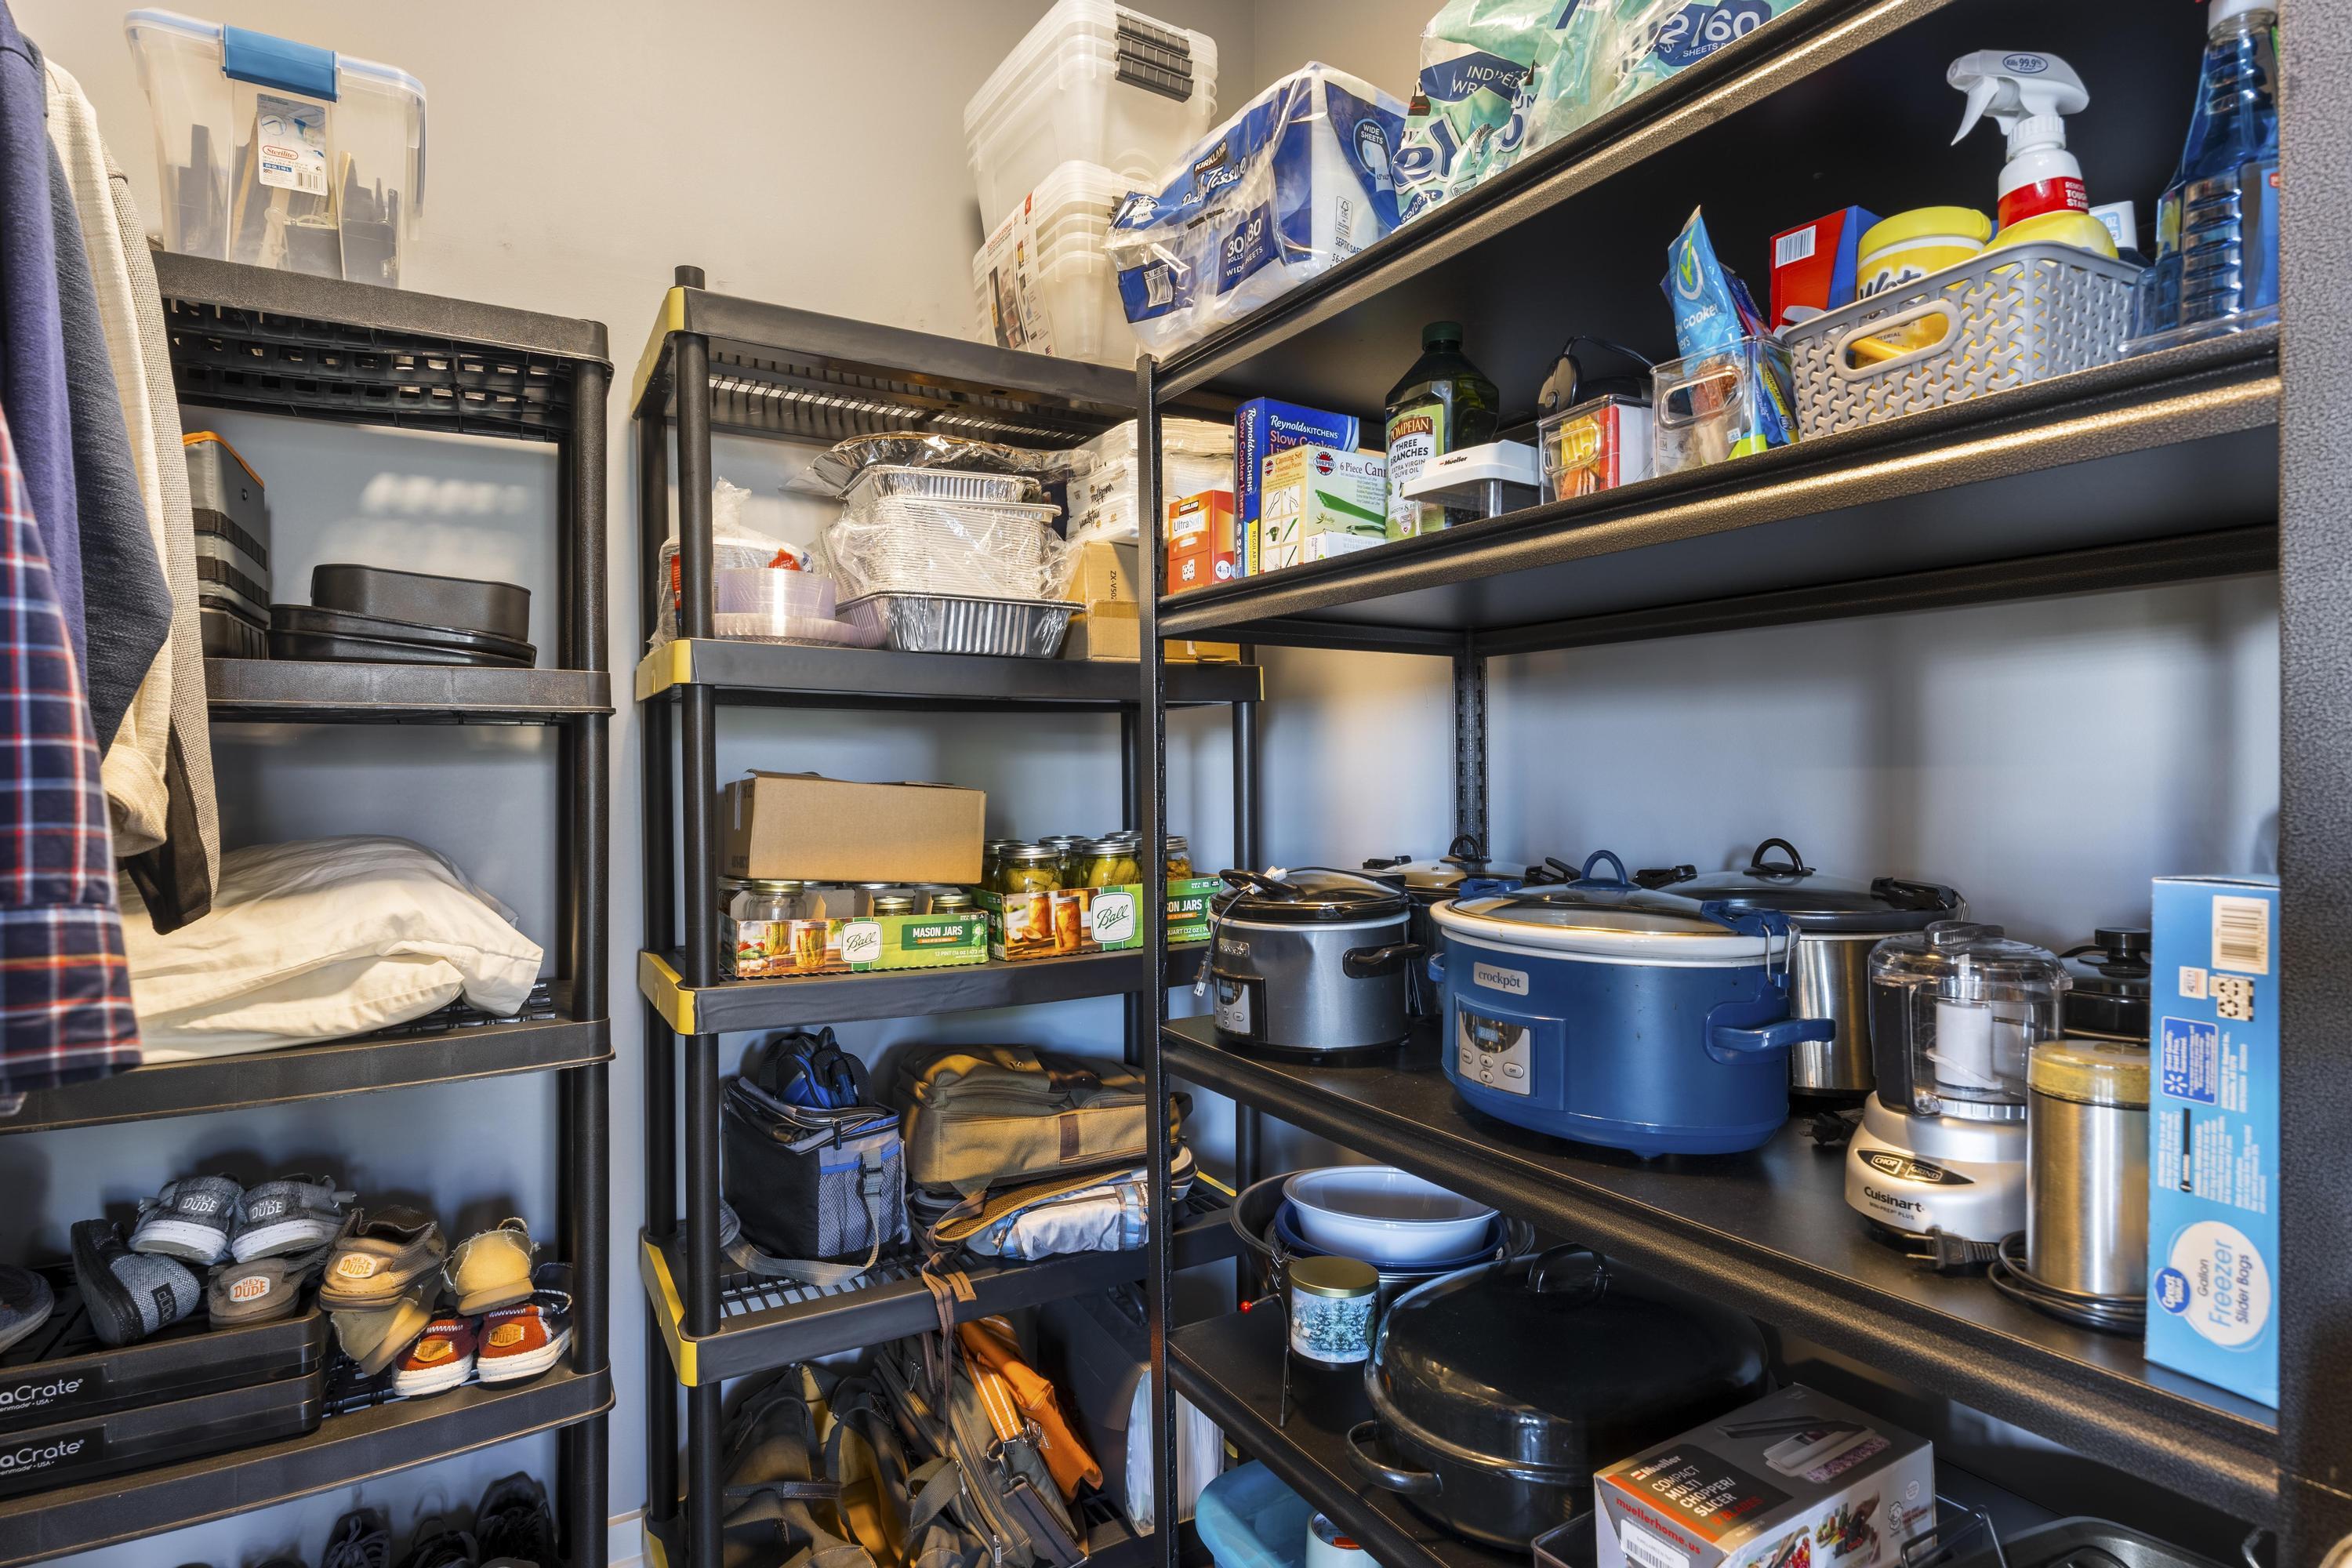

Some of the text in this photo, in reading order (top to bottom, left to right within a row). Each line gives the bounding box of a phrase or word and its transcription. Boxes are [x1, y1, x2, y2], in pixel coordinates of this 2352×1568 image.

[1682, 43, 1719, 58] SHEETS
[1363, 123, 1380, 136] WIDE
[1361, 131, 1383, 145] SHEETS
[267, 147, 296, 158] Sterilite
[1194, 141, 1228, 172] KIRKLAND
[1207, 157, 1247, 191] Tissue
[1227, 217, 1261, 258] 30 80
[1349, 245, 1363, 255] SAF
[1226, 246, 1263, 277] WIDE HEETS
[1227, 253, 1244, 264] ROLLS
[1270, 430, 1297, 445] Slow
[1390, 418, 1429, 443] POMPEIAN
[1396, 438, 1417, 452] THREE
[1315, 459, 1336, 468] NORPRO
[1390, 447, 1428, 466] BRANCHES
[1443, 456, 1468, 466] Mueller
[1340, 463, 1344, 471] 6
[1345, 463, 1363, 474] Piece
[1392, 459, 1425, 474] EXTRA VIRGIN
[1395, 469, 1408, 479] OLIVE
[1181, 898, 1203, 911] JARS
[1097, 903, 1129, 930] Ball
[913, 926, 963, 938] MASON JARS
[847, 931, 877, 952] Ball
[1479, 970, 1521, 989] crockpot
[1875, 1156, 1898, 1167] CHOP
[1910, 1165, 1940, 1179] GRIND
[183, 1197, 218, 1212] DUDE
[196, 1194, 213, 1203] HEY
[1864, 1186, 1924, 1213] Cuisinart
[251, 1201, 283, 1219] DUDE
[1897, 1211, 1915, 1220] PLUS
[342, 1259, 372, 1275] DUDE
[242, 1278, 260, 1287] HEY
[2197, 1258, 2210, 1297] Gallon
[2209, 1239, 2233, 1328] Freezer
[234, 1280, 266, 1298] DUDE
[2236, 1254, 2252, 1324] Slider Bags
[491, 1330, 520, 1344] DUDE
[1640, 1455, 1682, 1476] Mueller
[1651, 1465, 1700, 1493] COMPACT
[1664, 1479, 1703, 1501] MULTI
[1679, 1476, 1737, 1508] CHOPPER/
[1693, 1492, 1738, 1517] SLICER
[1616, 1497, 1701, 1555] muellerhome.us
